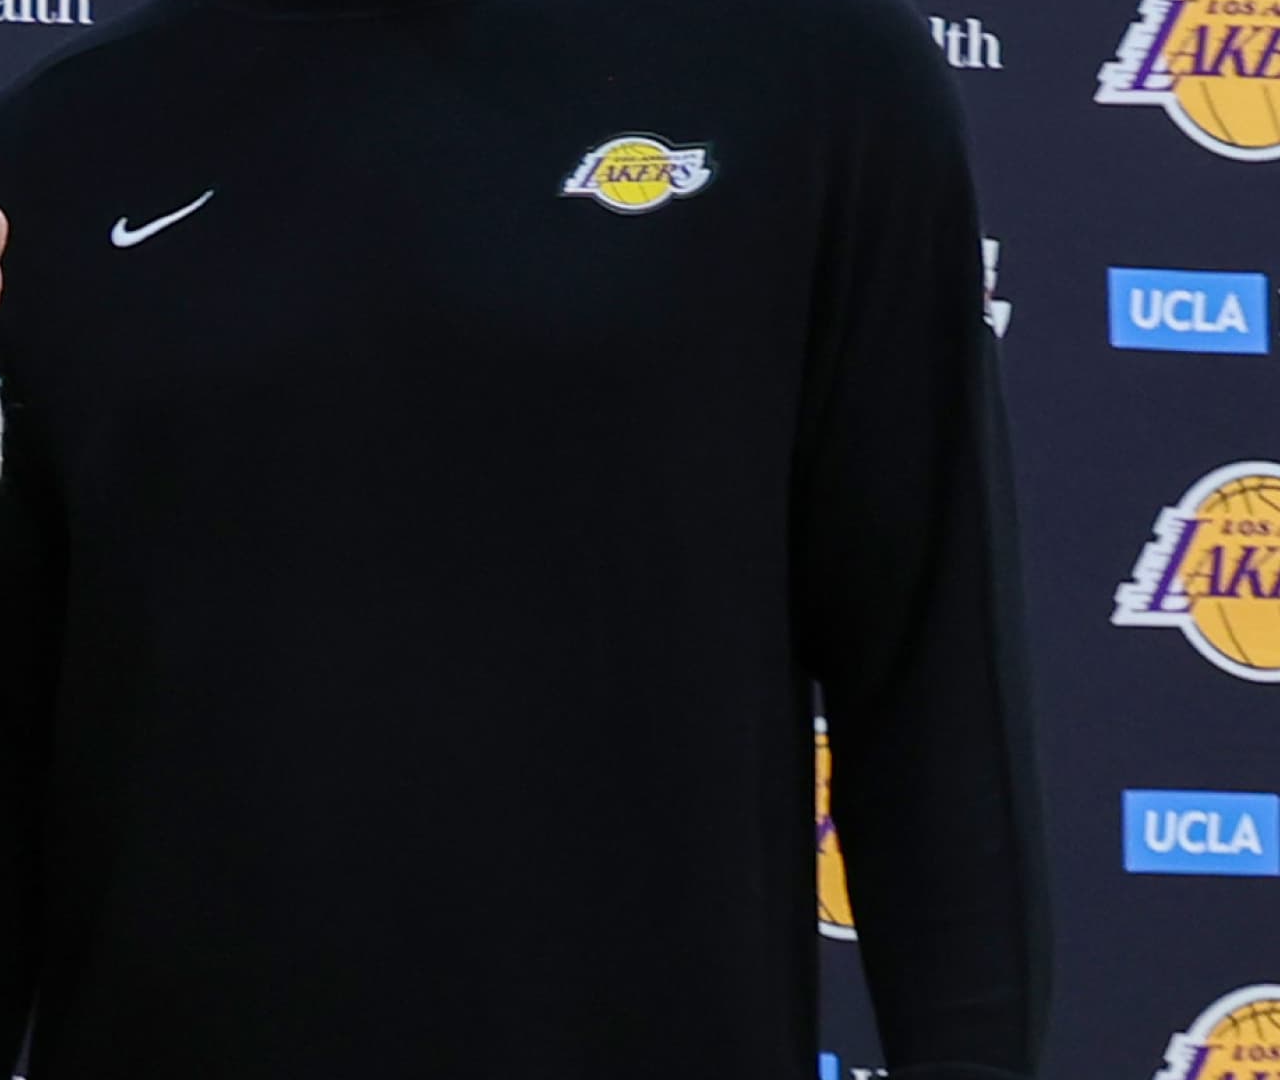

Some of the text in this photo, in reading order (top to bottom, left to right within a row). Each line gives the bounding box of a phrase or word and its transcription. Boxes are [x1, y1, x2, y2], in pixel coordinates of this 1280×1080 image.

[1206, 0, 1256, 16] LOS
[577, 156, 698, 190] LAKERS
[1129, 287, 1250, 333] UCLA
[1130, 518, 1280, 613] LAK
[1144, 810, 1263, 855] UCLA
